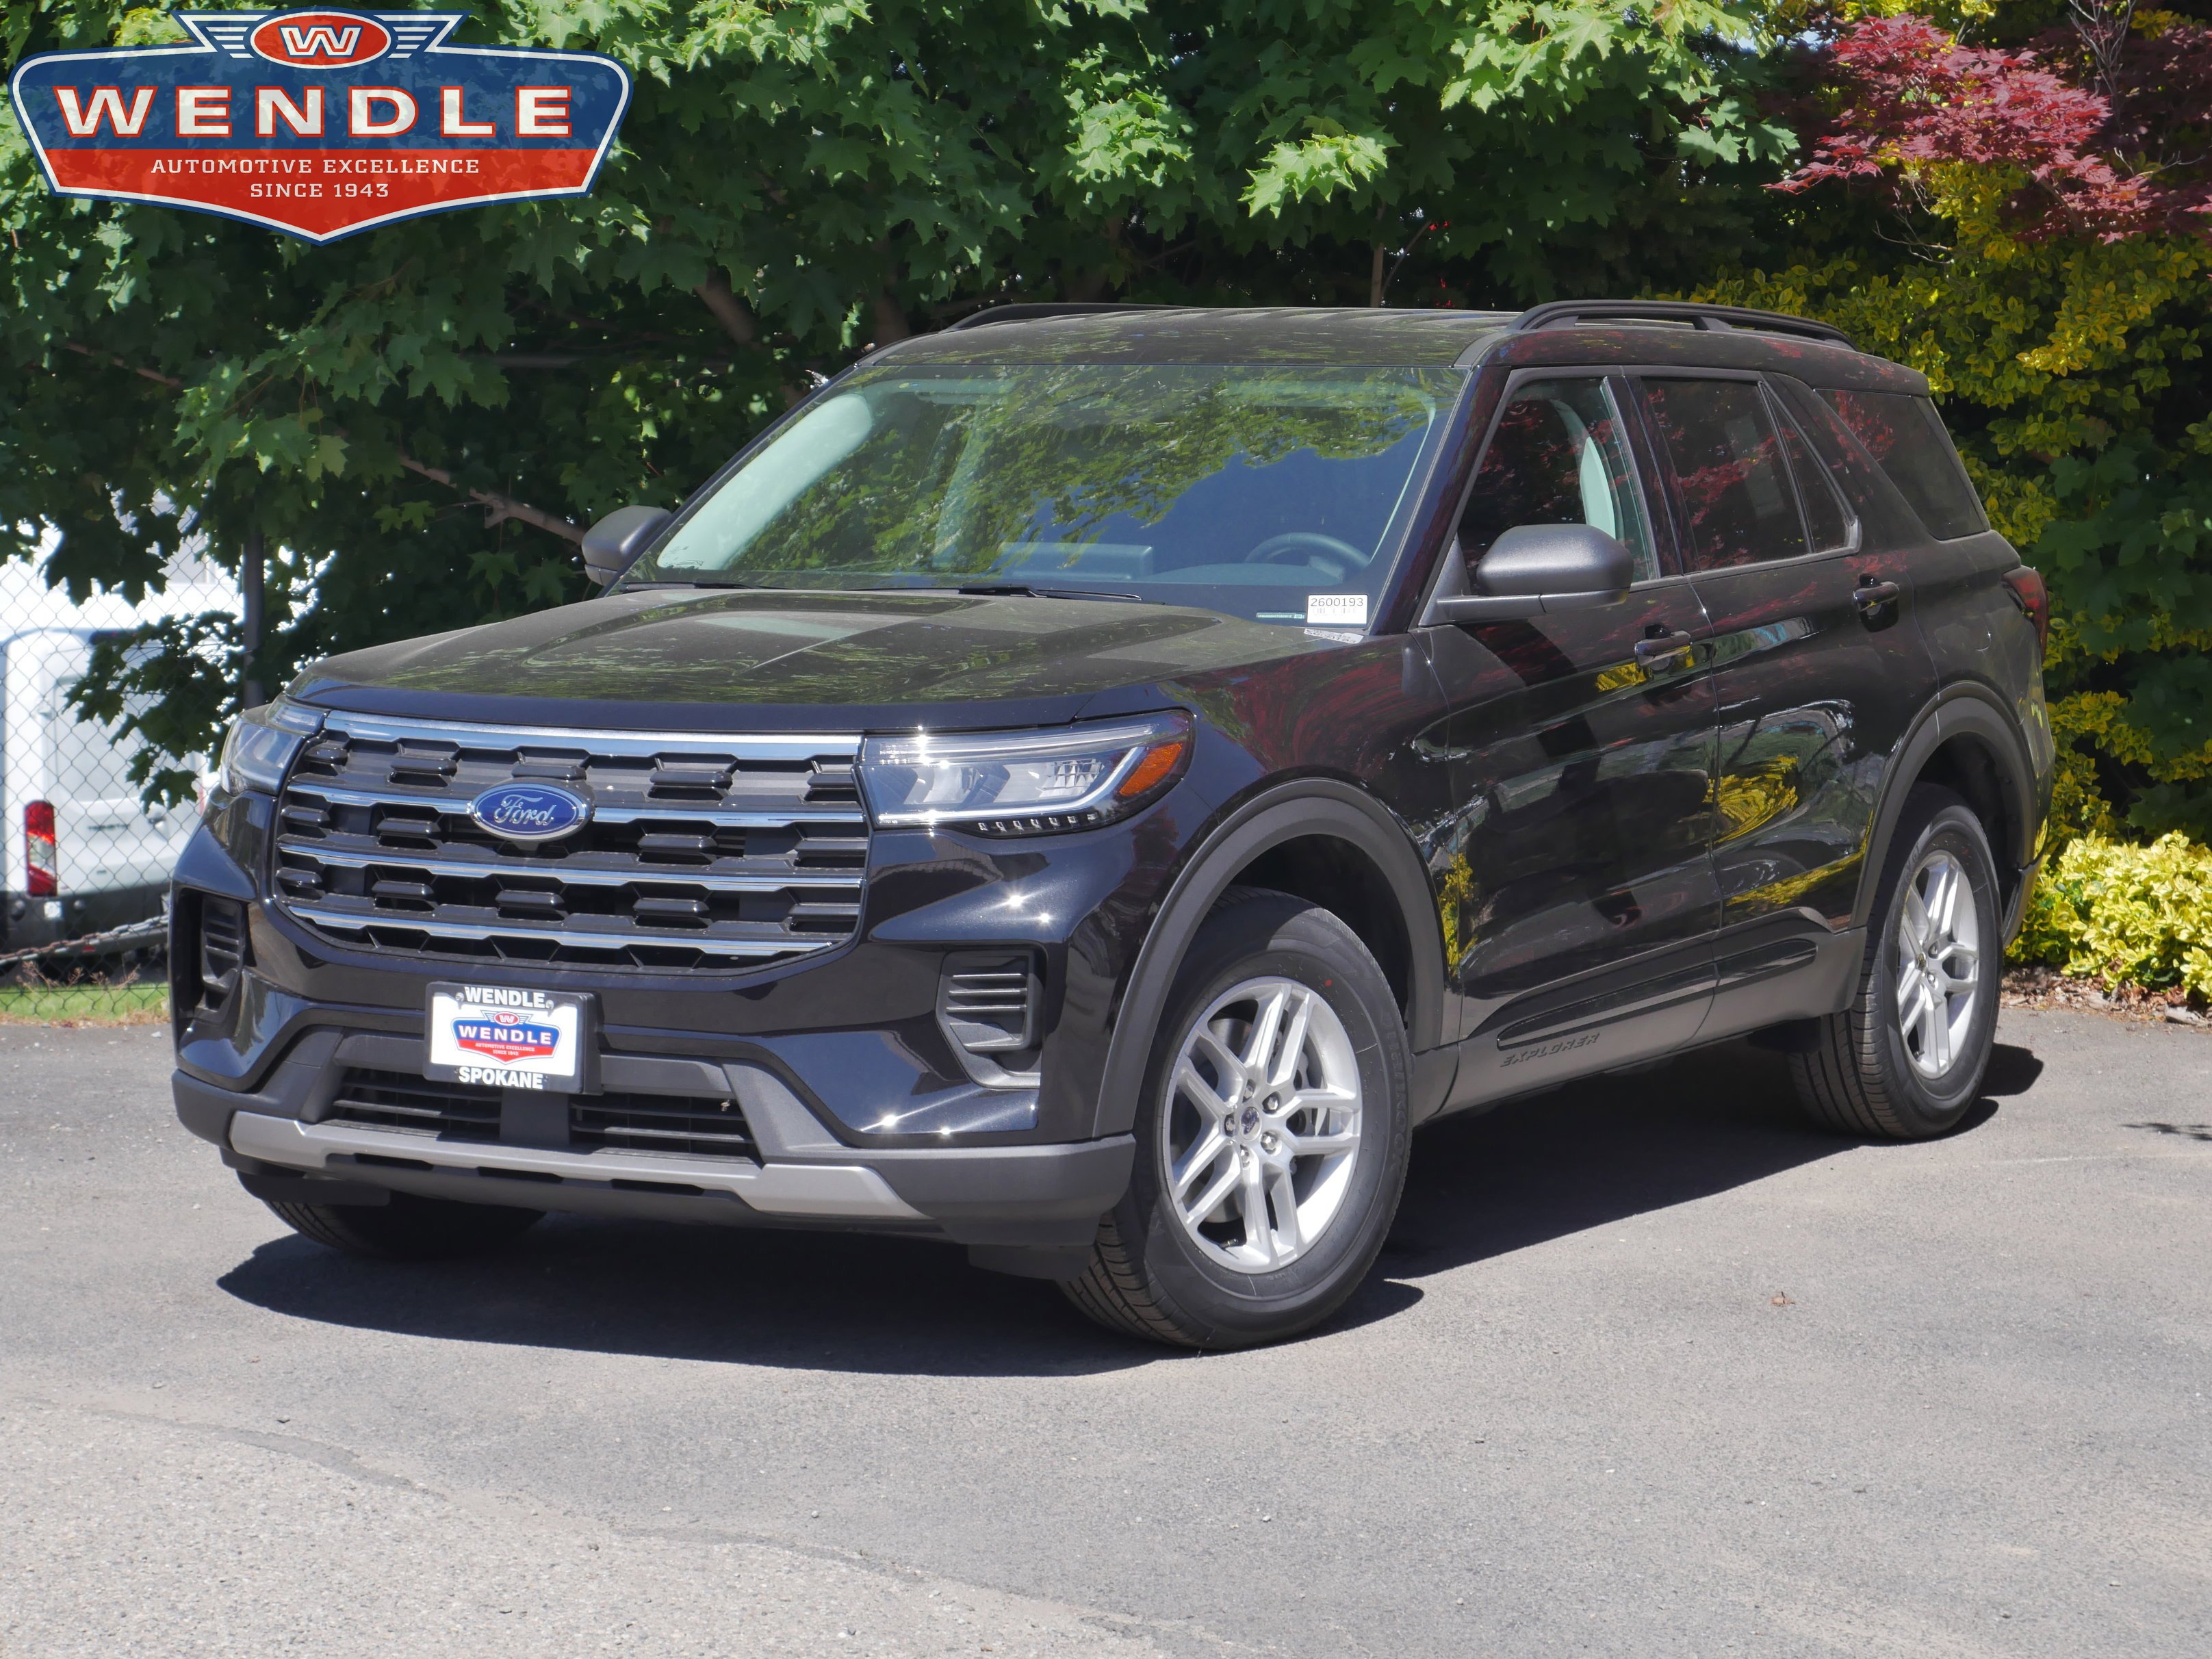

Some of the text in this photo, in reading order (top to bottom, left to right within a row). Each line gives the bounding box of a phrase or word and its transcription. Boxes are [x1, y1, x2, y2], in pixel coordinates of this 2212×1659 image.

[1311, 597, 1363, 606] 2600193
[494, 794, 556, 825] Ford
[464, 986, 545, 1008] WENDLE
[459, 1025, 551, 1045] WENDLE
[1500, 1033, 1600, 1067] EXPLORER
[459, 1067, 543, 1090] SPOKANE
